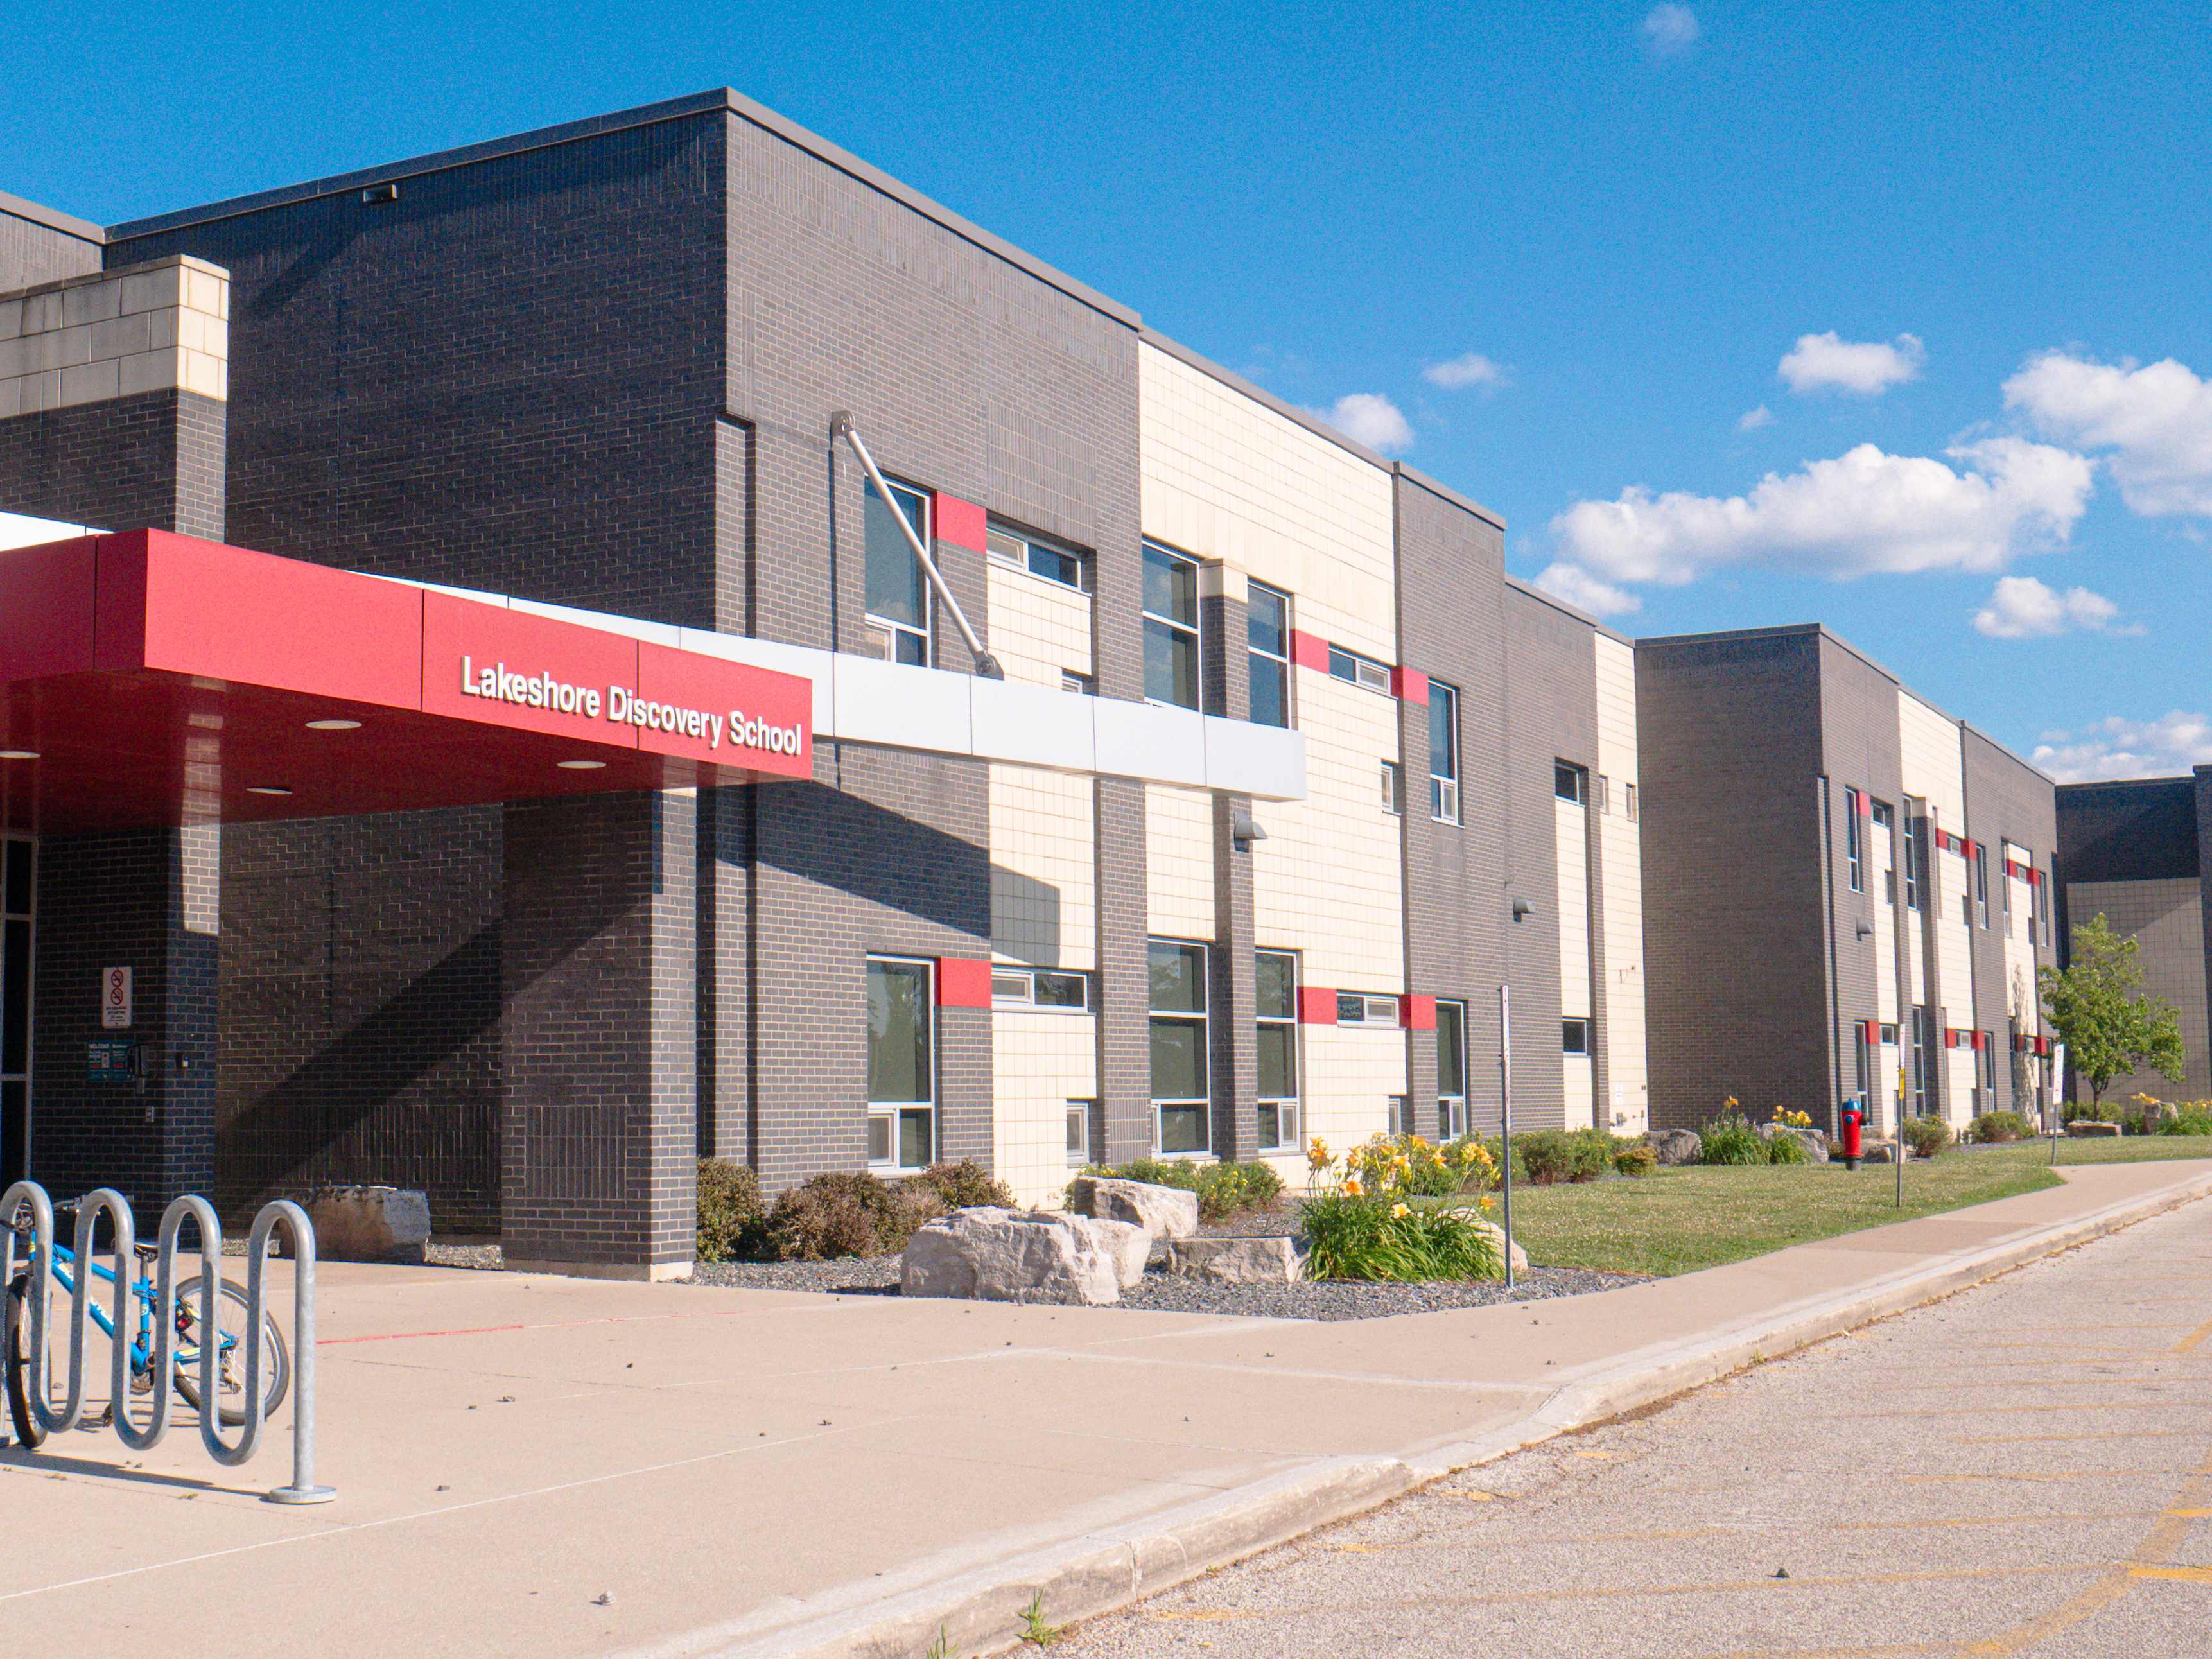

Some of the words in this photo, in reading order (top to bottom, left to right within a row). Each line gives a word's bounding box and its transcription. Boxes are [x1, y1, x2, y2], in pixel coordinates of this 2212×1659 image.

[461, 656, 600, 718] Lakeshore
[607, 685, 723, 749] Discovery
[729, 710, 801, 756] School
